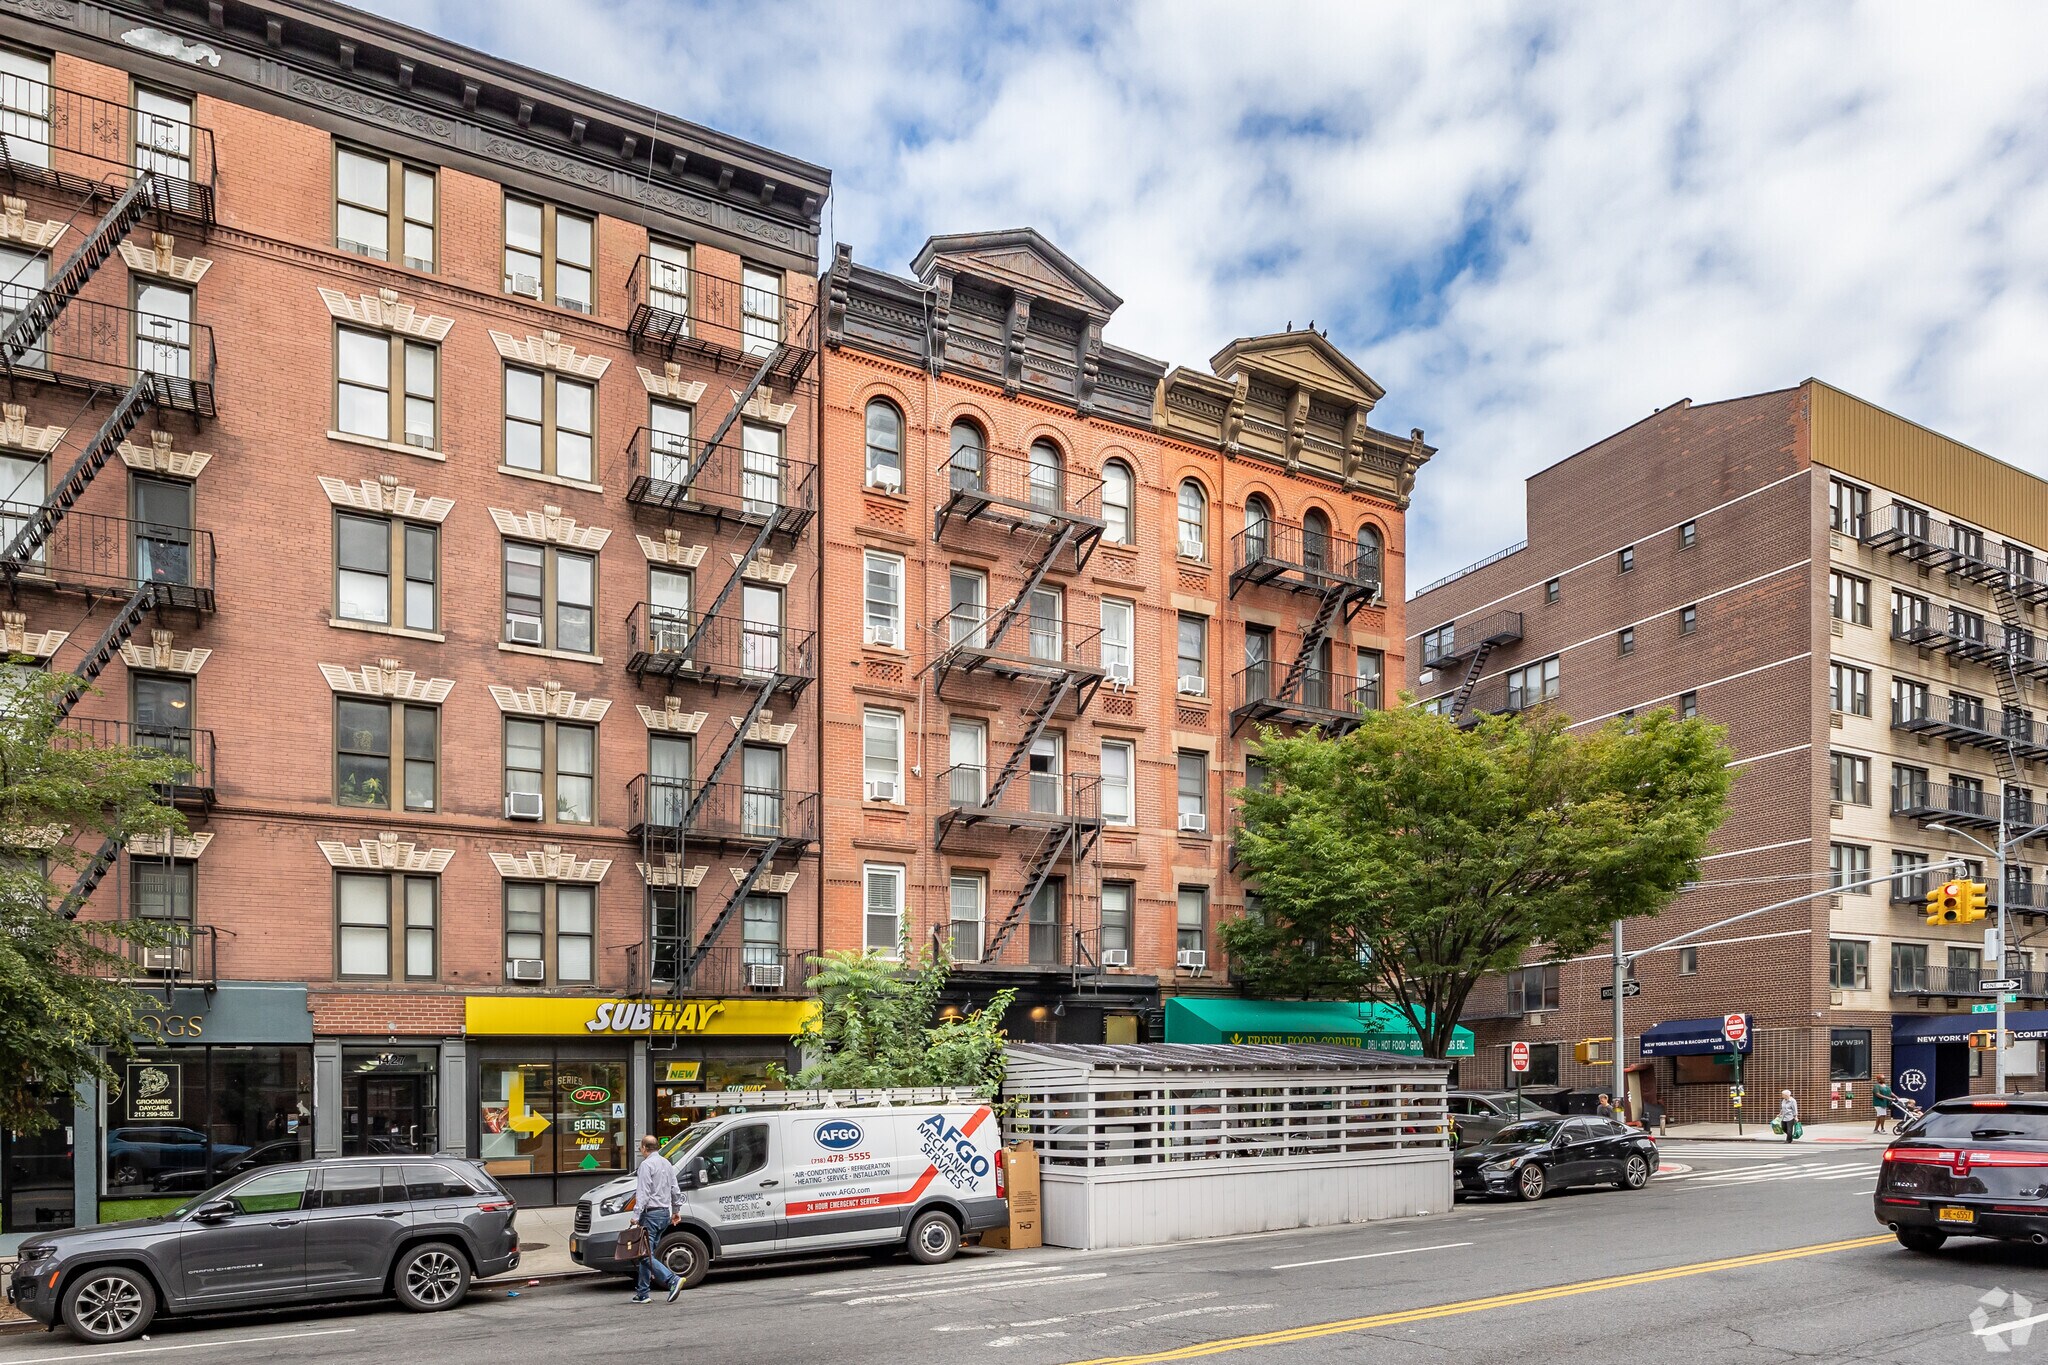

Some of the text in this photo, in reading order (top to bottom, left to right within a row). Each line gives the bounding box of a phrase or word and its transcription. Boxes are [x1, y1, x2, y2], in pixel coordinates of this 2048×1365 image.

[585, 1001, 726, 1032] SUBWAY
[1248, 1036, 1282, 1045] FRESH
[1320, 1036, 1362, 1048] CORNER
[1368, 1040, 1378, 1050] DELI
[1382, 1041, 1391, 1050] HOT
[1392, 1041, 1406, 1050] FOOD
[376, 1054, 406, 1065] 1427
[670, 1070, 694, 1078] NEW
[575, 1090, 605, 1100] OPEN
[615, 1105, 622, 1114] A
[574, 1119, 606, 1130] SERIES
[820, 1129, 859, 1140] AFGO
[924, 1114, 989, 1177] AFGO
[827, 1152, 871, 1163] 478-5555
[917, 1123, 979, 1192] MECHANICAL
[851, 1162, 891, 1171] REFRIGERATION
[920, 1143, 964, 1189] SERVICES
[798, 1170, 890, 1185] HEATING SERVICE INSTALLATION
[734, 1193, 764, 1201] MECHANICAL
[819, 1188, 870, 1197] www.AFGO.com
[815, 1202, 828, 1210] HOUR
[830, 1199, 858, 1208] EMERGENCY
[860, 1197, 880, 1205] SERVICE
